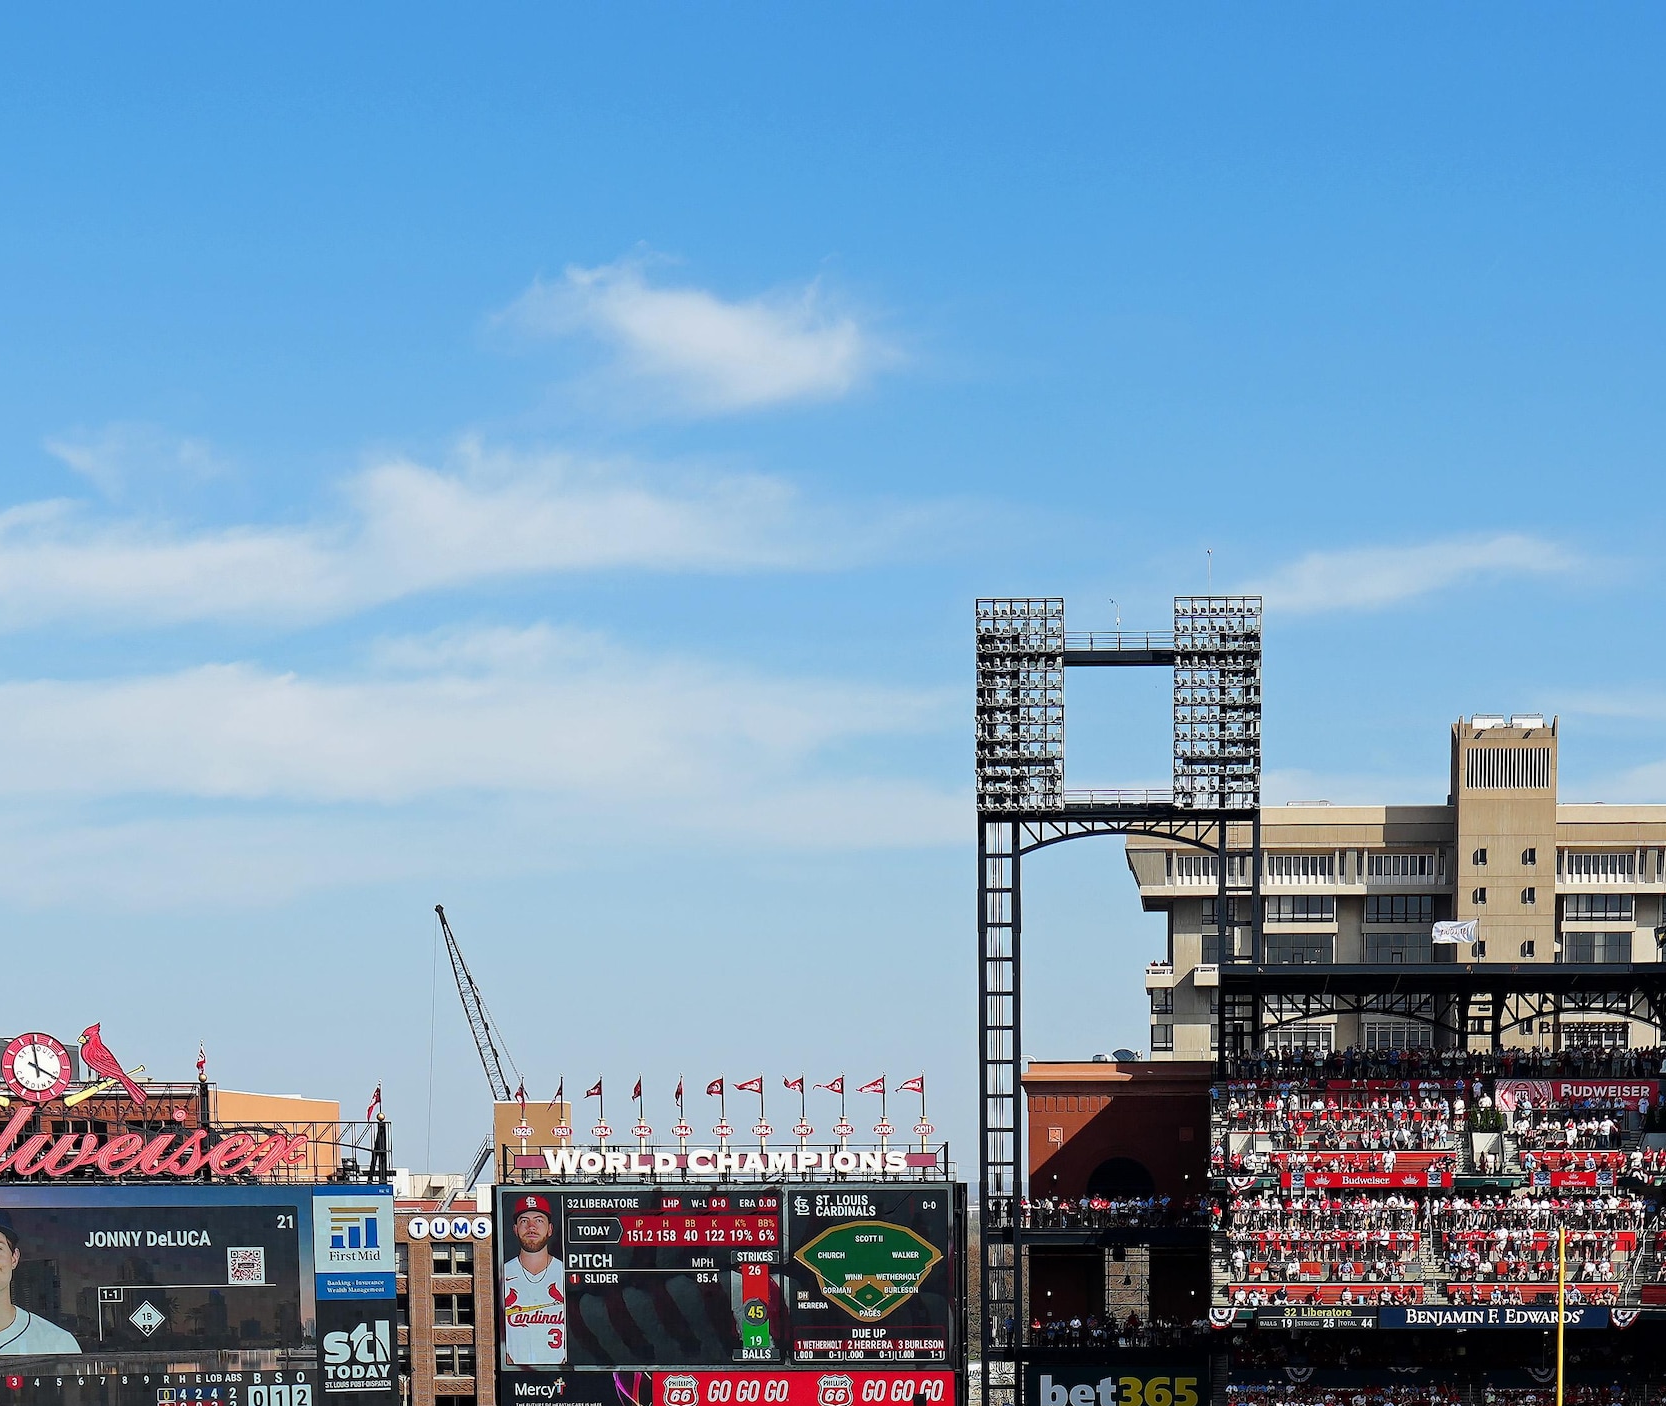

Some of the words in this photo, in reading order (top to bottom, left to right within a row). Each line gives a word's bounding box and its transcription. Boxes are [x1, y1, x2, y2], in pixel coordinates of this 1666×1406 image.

[1560, 1084, 1650, 1099] BUDWEISER
[633, 1127, 651, 1136] 1942
[834, 1126, 852, 1134] 1982
[915, 1125, 932, 1133] 2011
[543, 1149, 678, 1175] WORLD
[686, 1149, 908, 1174] CHAMPIONS
[1342, 1176, 1390, 1185] Budweiser
[580, 1199, 639, 1208] LIBERATORE
[663, 1199, 679, 1208] LHP
[816, 1195, 833, 1206] ST.
[836, 1195, 868, 1205] LOUIS
[815, 1206, 876, 1217] CARDINALS
[415, 1222, 486, 1234] TUMS
[577, 1226, 610, 1236] TODAY
[85, 1231, 142, 1248] JONNY
[146, 1230, 211, 1247] DeLUCA
[855, 1235, 877, 1243] SCOTT
[329, 1251, 356, 1261] First
[358, 1251, 380, 1260] Mid
[568, 1254, 613, 1268] PITCH
[736, 1252, 773, 1262] STRIKES
[584, 1274, 619, 1284] SLIDER
[1301, 1307, 1352, 1317] Liberatore
[1406, 1309, 1484, 1324] BENJAMIN
[1487, 1310, 1500, 1323] F.
[852, 1329, 871, 1338] DUE
[873, 1329, 886, 1338] UP
[323, 1320, 391, 1363] stl
[742, 1349, 771, 1360] BALLS
[325, 1364, 391, 1379] TODAY
[667, 1379, 694, 1388] PHILLIPS
[515, 1382, 556, 1398] Mercy
[670, 1390, 692, 1402] 66
